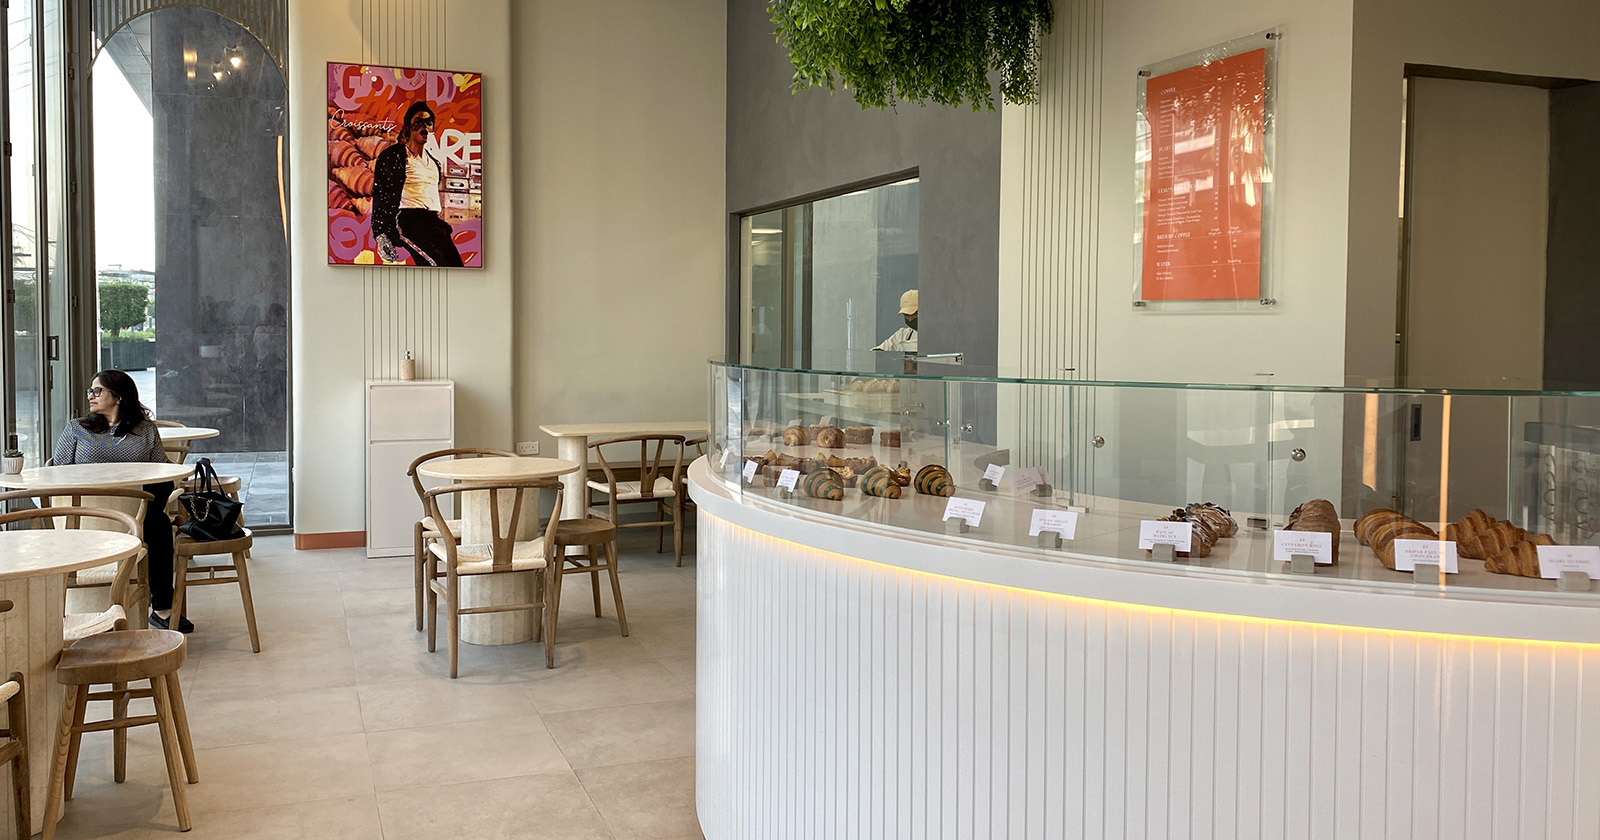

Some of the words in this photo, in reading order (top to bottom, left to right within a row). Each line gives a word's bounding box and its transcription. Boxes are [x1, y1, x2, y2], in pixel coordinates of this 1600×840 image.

[333, 65, 457, 111] GOOD
[330, 109, 398, 133] Croissants
[354, 84, 480, 144] thigs
[424, 129, 481, 165] ARE
